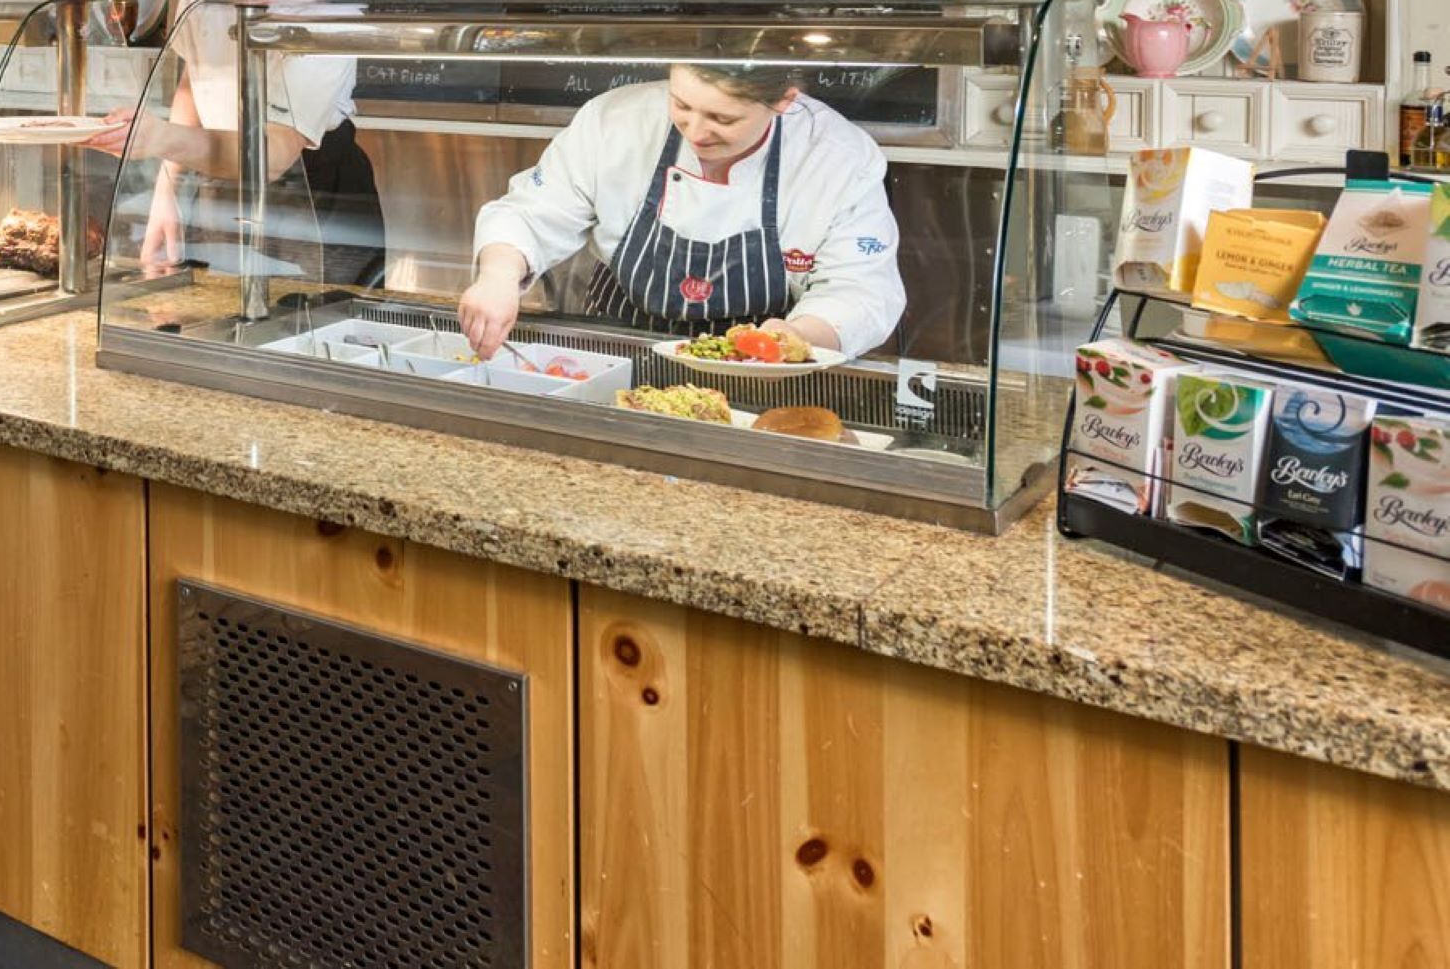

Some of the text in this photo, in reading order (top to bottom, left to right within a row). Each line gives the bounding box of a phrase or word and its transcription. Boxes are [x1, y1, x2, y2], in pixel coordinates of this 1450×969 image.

[564, 75, 591, 92] ALL
[1328, 257, 1407, 275] HERBAL TEA
[1179, 442, 1244, 477] Bewley's
[1271, 456, 1348, 493] Bewley's
[1374, 495, 1449, 537] Bewley
